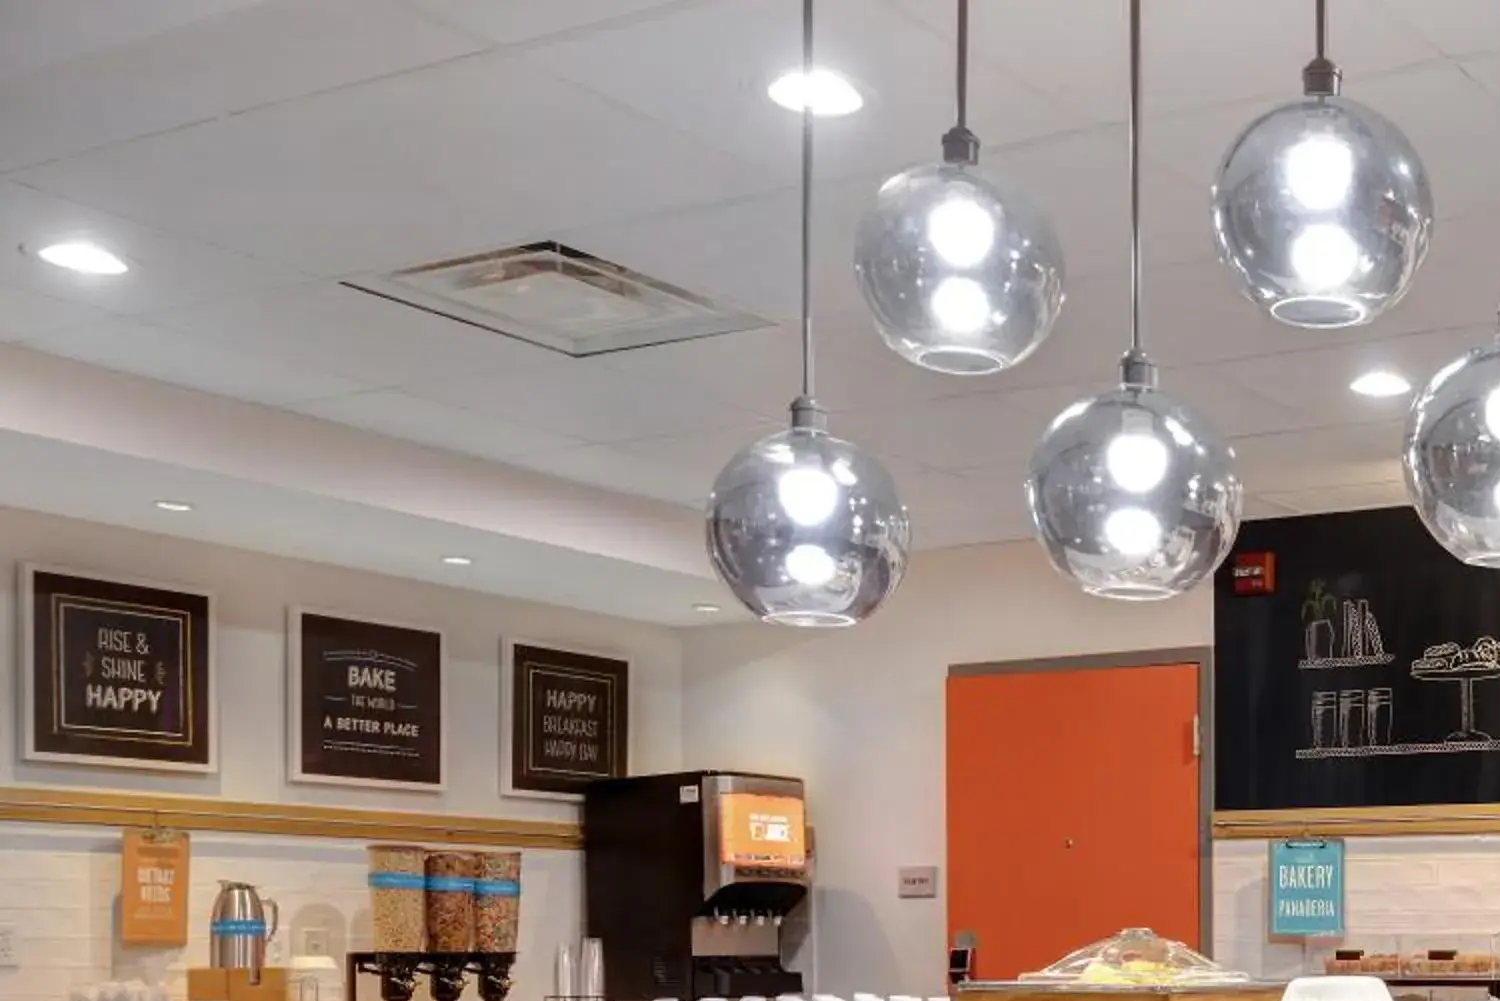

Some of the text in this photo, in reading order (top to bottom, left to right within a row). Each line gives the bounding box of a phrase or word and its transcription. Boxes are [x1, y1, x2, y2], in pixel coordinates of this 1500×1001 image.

[98, 627, 149, 654] RISE &
[101, 655, 146, 683] SHINE
[347, 665, 396, 693] BAKE
[86, 683, 162, 714] HAPPY
[546, 689, 597, 713] HAPPY
[323, 714, 420, 737] A BETTER PLACE
[543, 715, 599, 737] BREAKFAST
[1279, 864, 1334, 889] BAKERY
